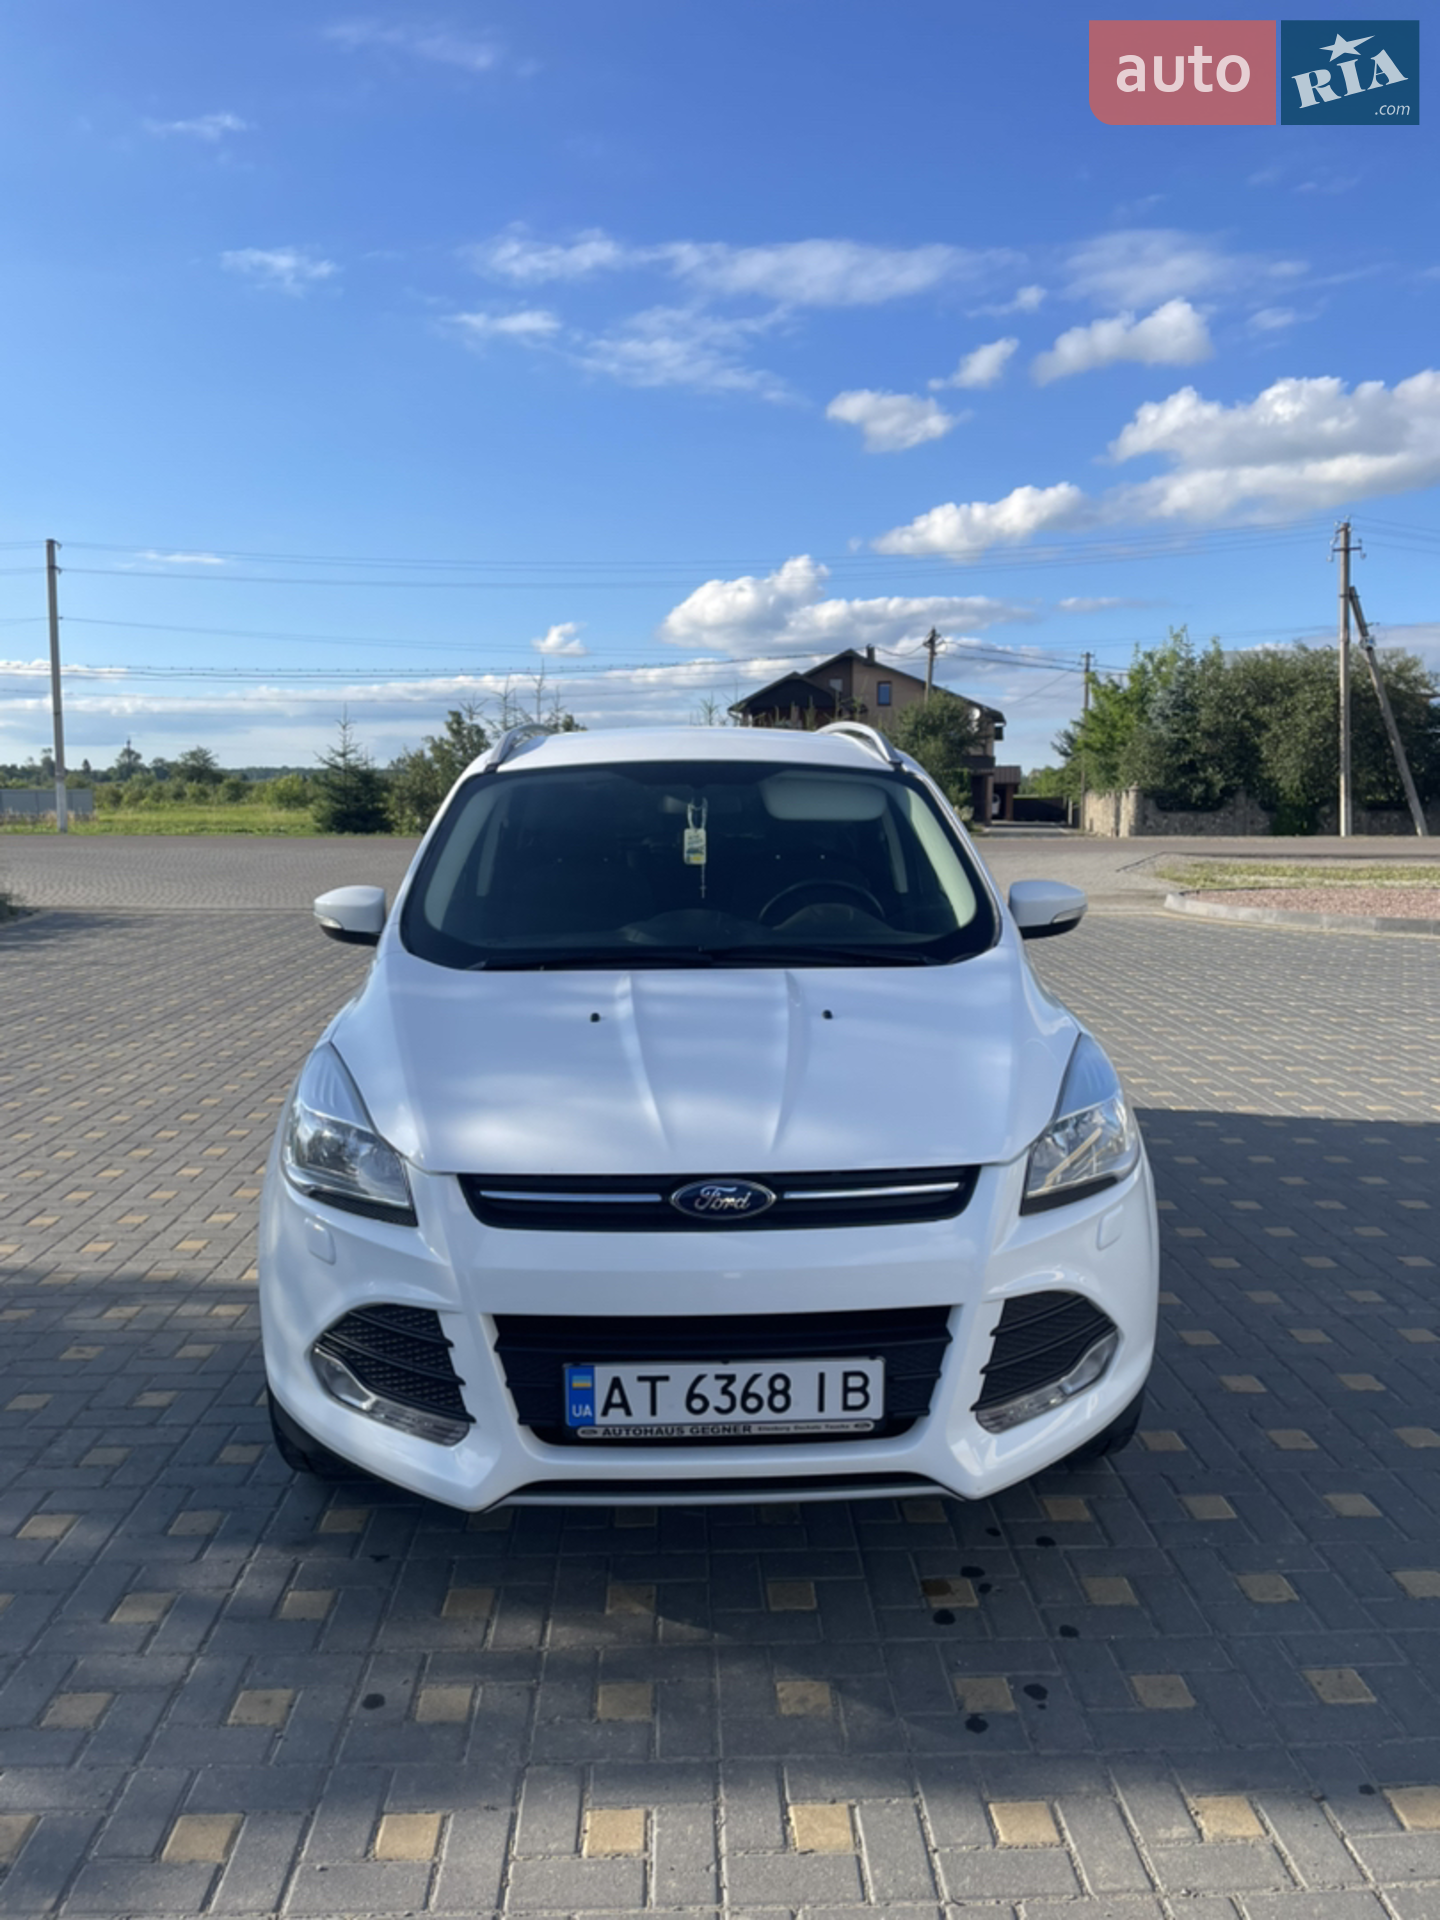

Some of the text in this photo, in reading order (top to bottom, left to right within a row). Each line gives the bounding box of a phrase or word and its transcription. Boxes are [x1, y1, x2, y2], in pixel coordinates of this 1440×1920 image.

[694, 1185, 752, 1211] Ford
[600, 1370, 871, 1417] AT 6368 IB
[572, 1404, 593, 1418] UA
[602, 1426, 685, 1437] AUTOHAUS
[689, 1425, 752, 1436] GEGNER
